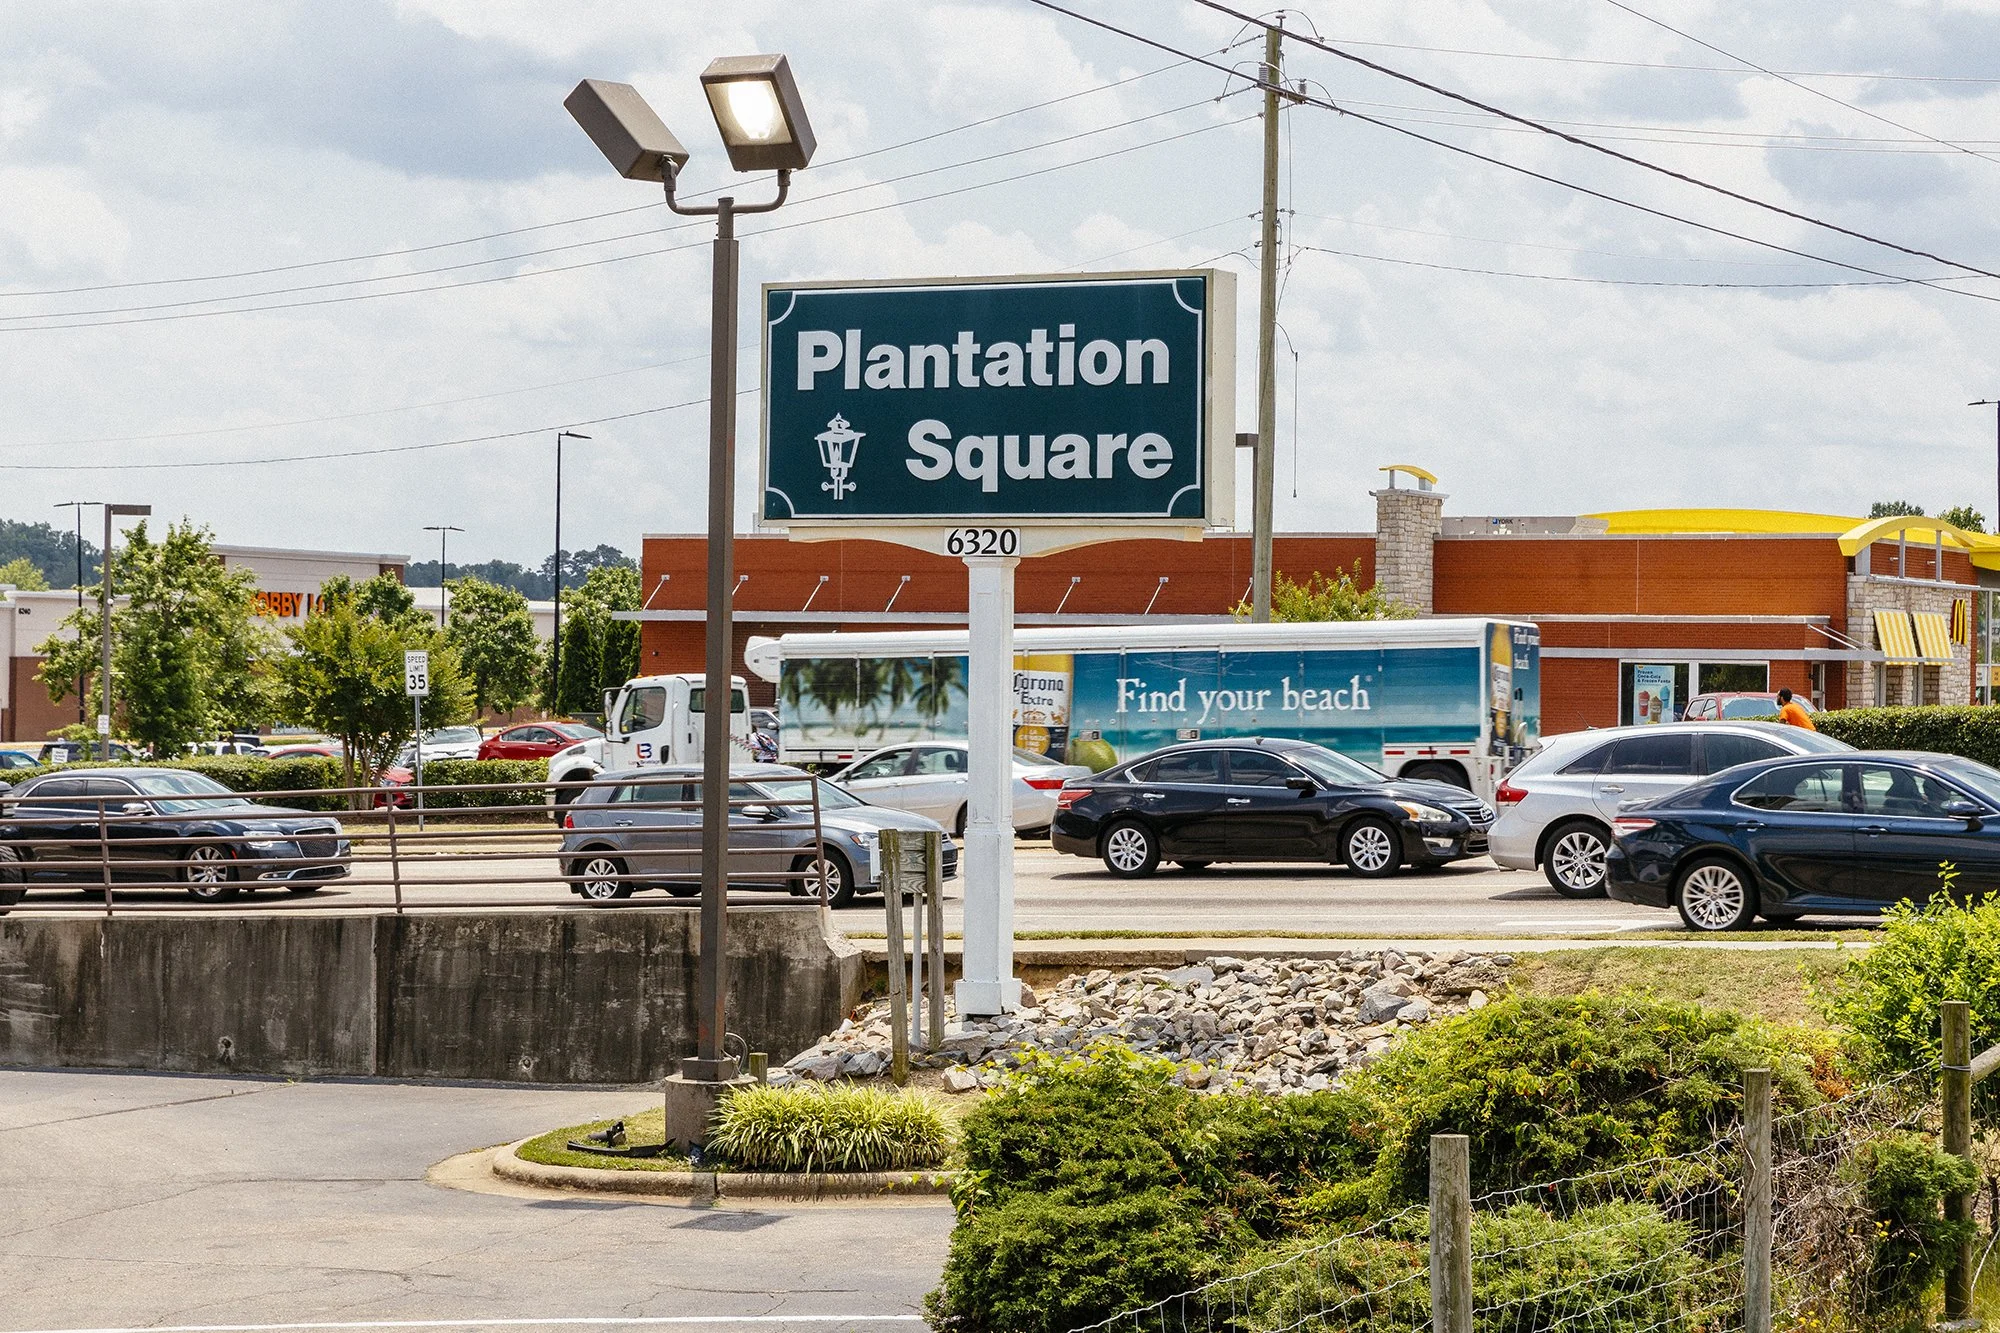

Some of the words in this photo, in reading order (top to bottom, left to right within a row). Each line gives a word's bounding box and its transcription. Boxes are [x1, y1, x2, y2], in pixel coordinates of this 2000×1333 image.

[797, 323, 1170, 391] Plantation
[905, 418, 1174, 493] Square
[946, 528, 1018, 556] 6320
[407, 655, 425, 664] SPEED
[409, 674, 426, 690] 35
[1013, 672, 1065, 694] Corona
[1020, 691, 1054, 706] Extra
[1116, 677, 1187, 713] Find
[1197, 689, 1271, 724] your
[1281, 675, 1371, 711] beach
